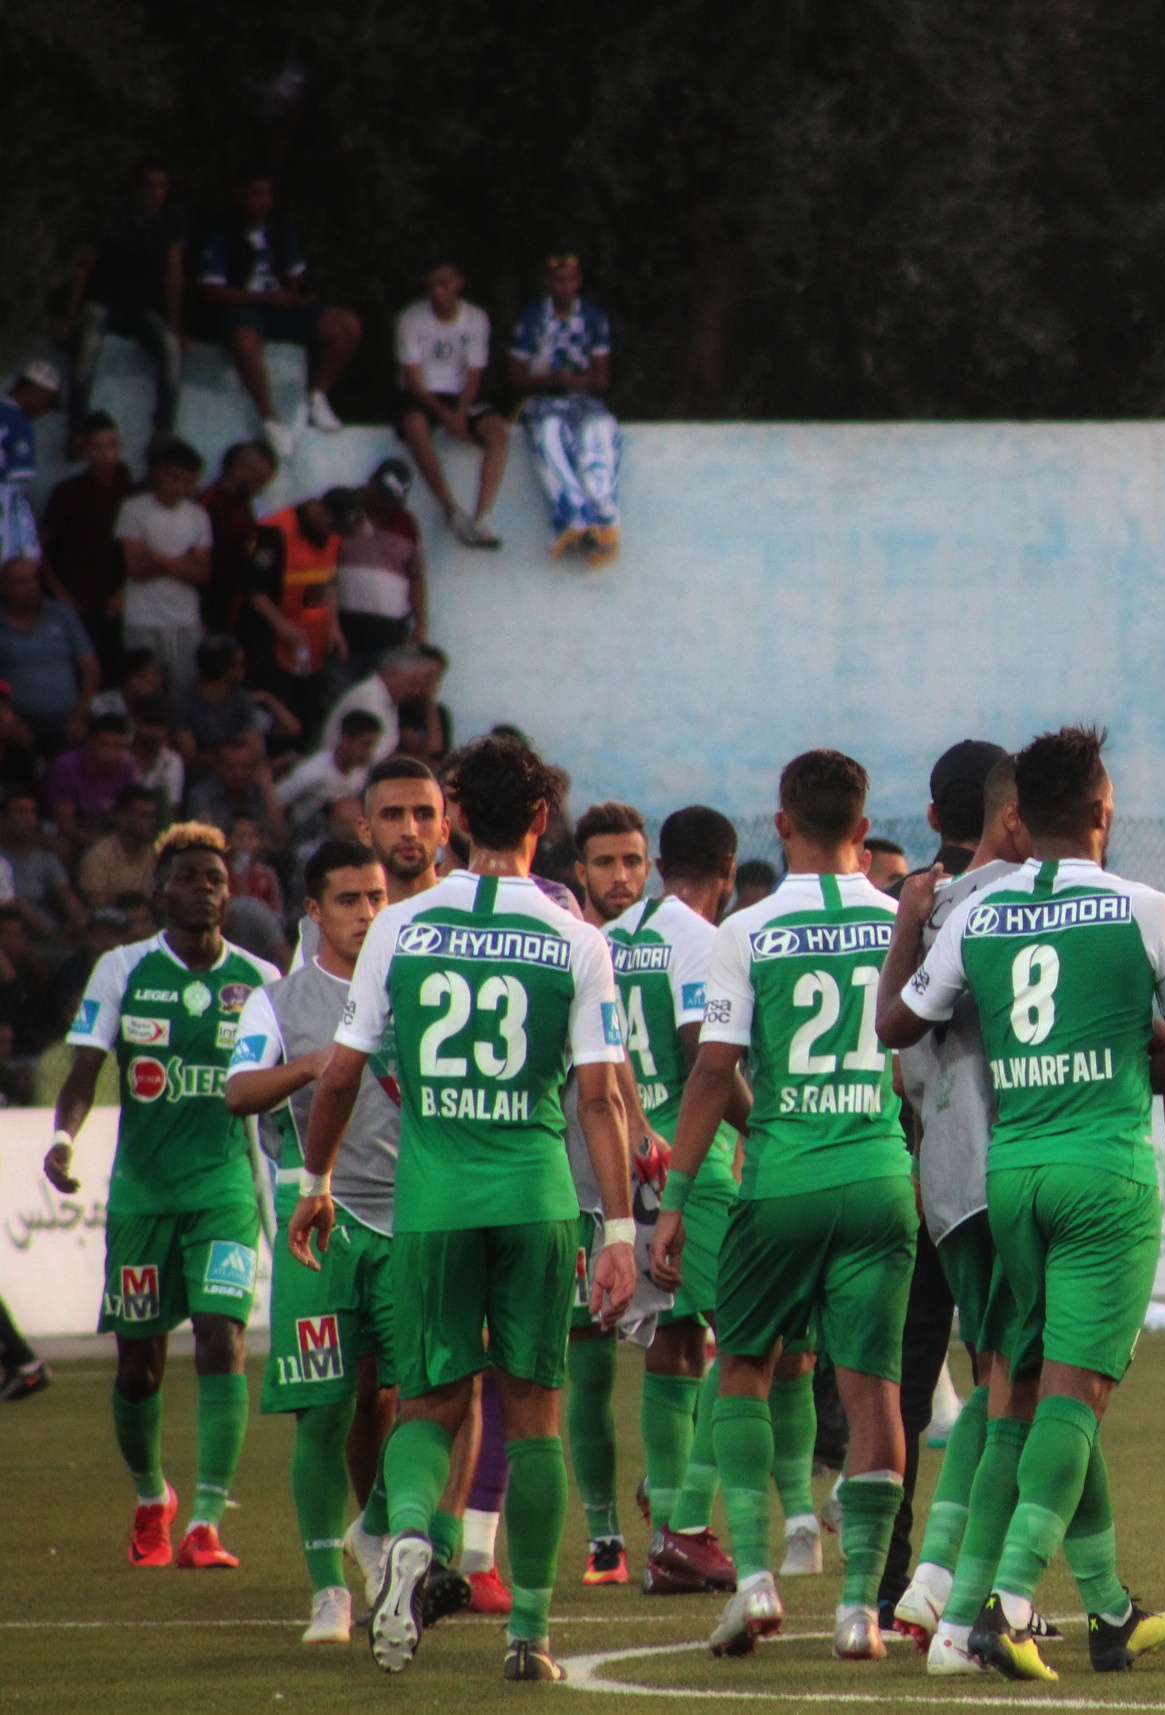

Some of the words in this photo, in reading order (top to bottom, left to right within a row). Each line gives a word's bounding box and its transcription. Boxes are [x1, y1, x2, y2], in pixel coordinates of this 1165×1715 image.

[1006, 898, 1128, 932] HYUNDAI
[450, 931, 569, 966] HYUNDAI
[806, 926, 893, 951] HYUND
[134, 989, 179, 1003] LEGEA
[1010, 944, 1060, 1046] 8
[419, 970, 528, 1081] 23
[788, 966, 886, 1074] 21
[166, 1055, 229, 1104] SIER
[421, 1086, 528, 1121] B.SALAH
[277, 1355, 302, 1385] 11
